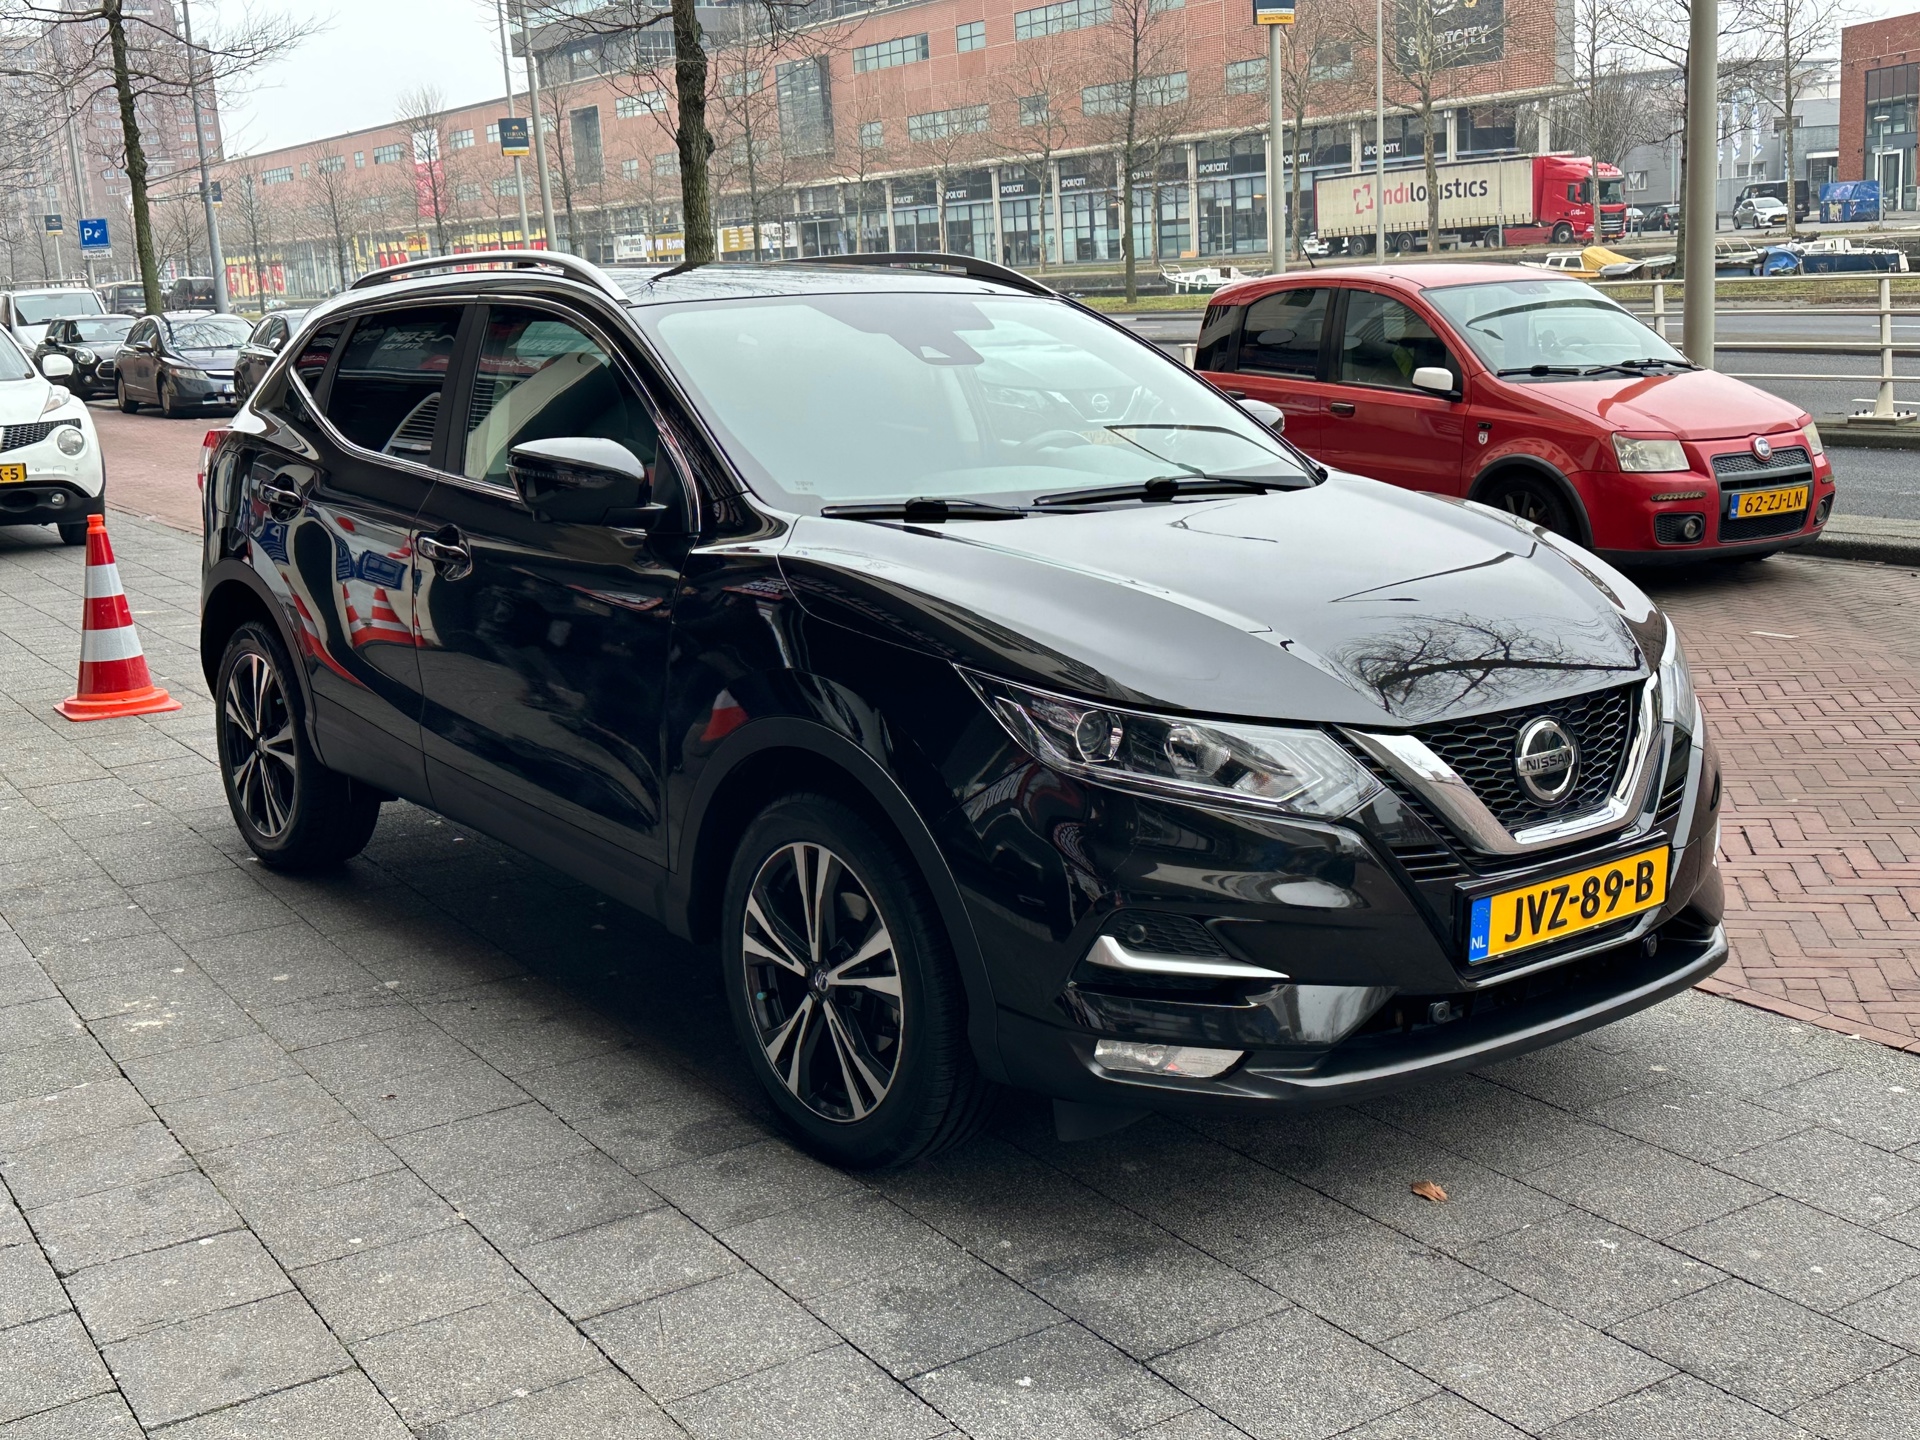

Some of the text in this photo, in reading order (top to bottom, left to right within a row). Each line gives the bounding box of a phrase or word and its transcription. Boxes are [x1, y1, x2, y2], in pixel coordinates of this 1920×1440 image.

[83, 227, 93, 241] P
[1745, 490, 1803, 514] 62-ZJ-LN
[1526, 752, 1572, 771] NISSAN
[1504, 860, 1655, 943] JVZ-89-B
[1471, 934, 1487, 950] NL
